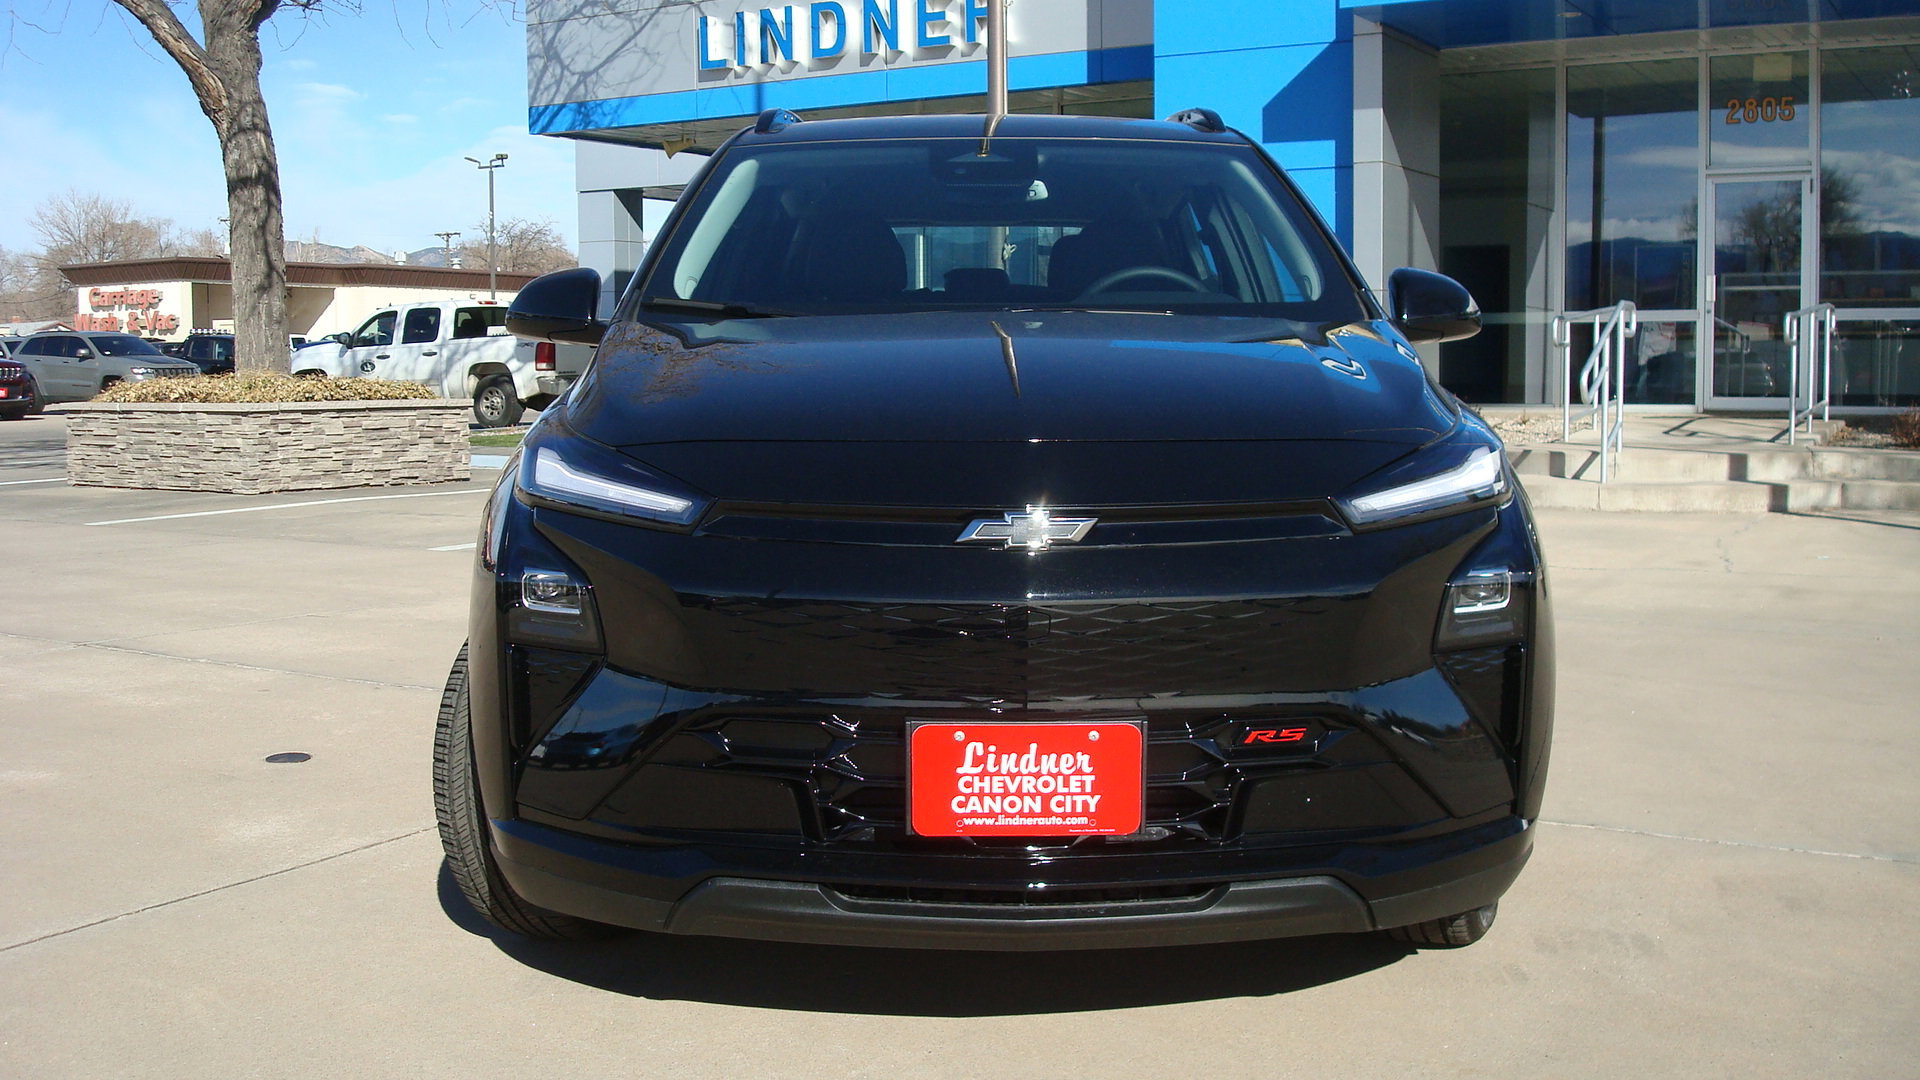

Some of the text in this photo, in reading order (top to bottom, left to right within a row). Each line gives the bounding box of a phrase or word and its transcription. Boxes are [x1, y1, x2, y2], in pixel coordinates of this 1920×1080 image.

[1726, 96, 1795, 124] 2805
[89, 287, 160, 309] Carriage
[74, 311, 176, 331] Wash & Vac
[1244, 728, 1307, 744] RS
[956, 741, 1094, 775] Lindner
[957, 775, 1096, 794] CHEVROLET
[951, 795, 1101, 814] CANON CITY
[963, 815, 1088, 826] www.lindnerauto.com
